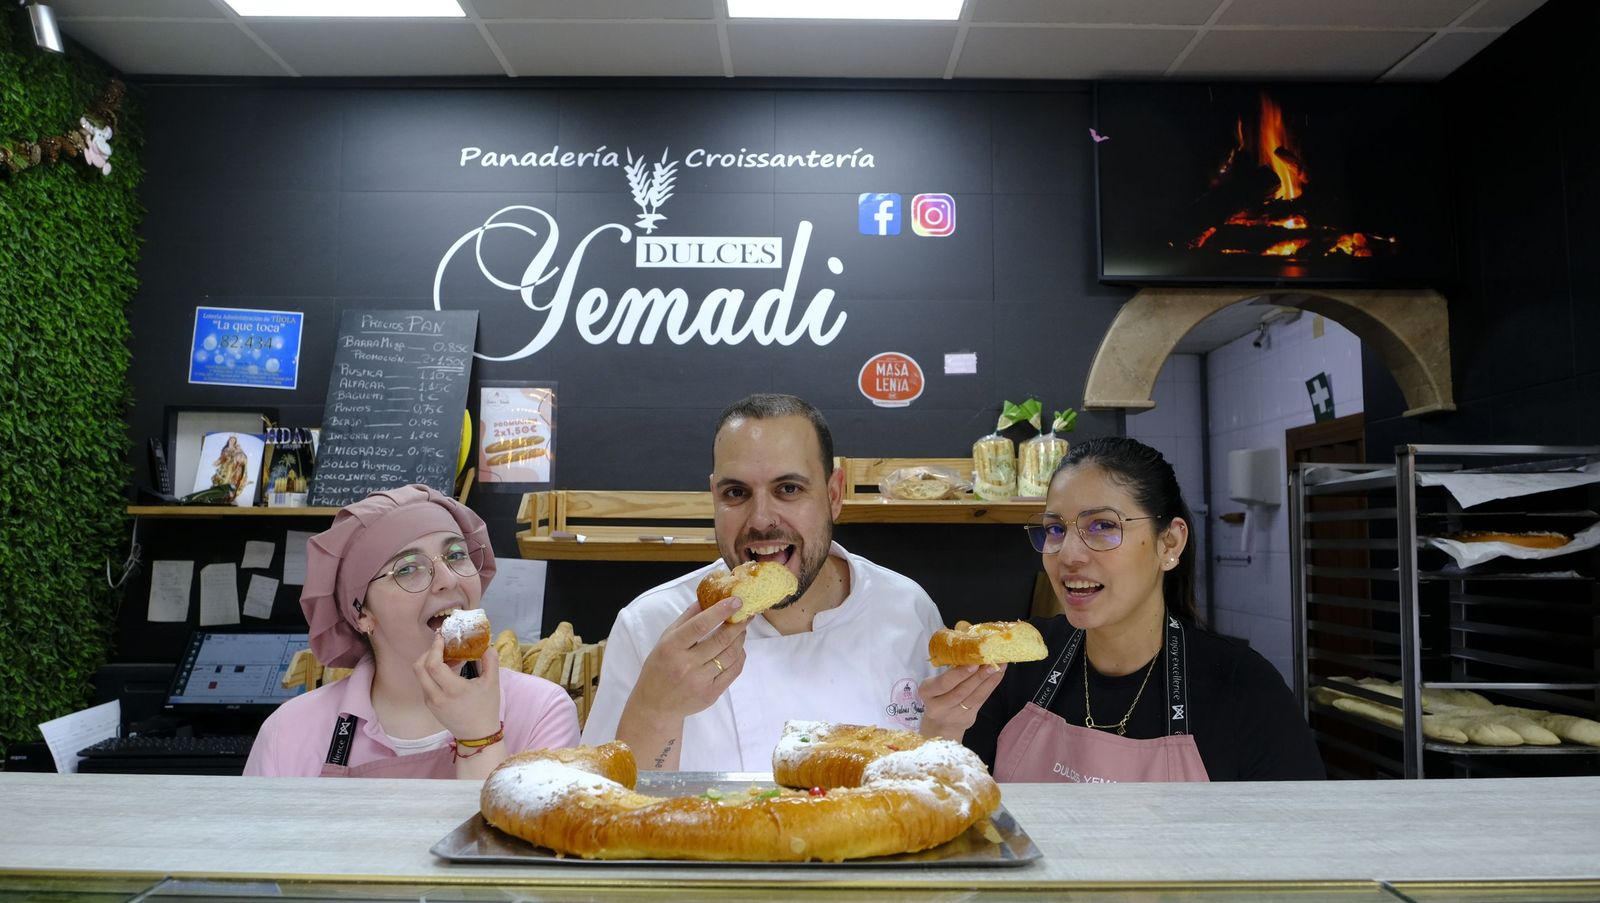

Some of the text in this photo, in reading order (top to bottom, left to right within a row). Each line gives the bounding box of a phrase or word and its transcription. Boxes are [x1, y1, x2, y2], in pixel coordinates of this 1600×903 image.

[459, 146, 875, 169] Panadería Croissantería
[644, 242, 776, 265] DULCES
[433, 204, 848, 362] Yemadi
[233, 322, 253, 333] que
[876, 362, 909, 377] MASA
